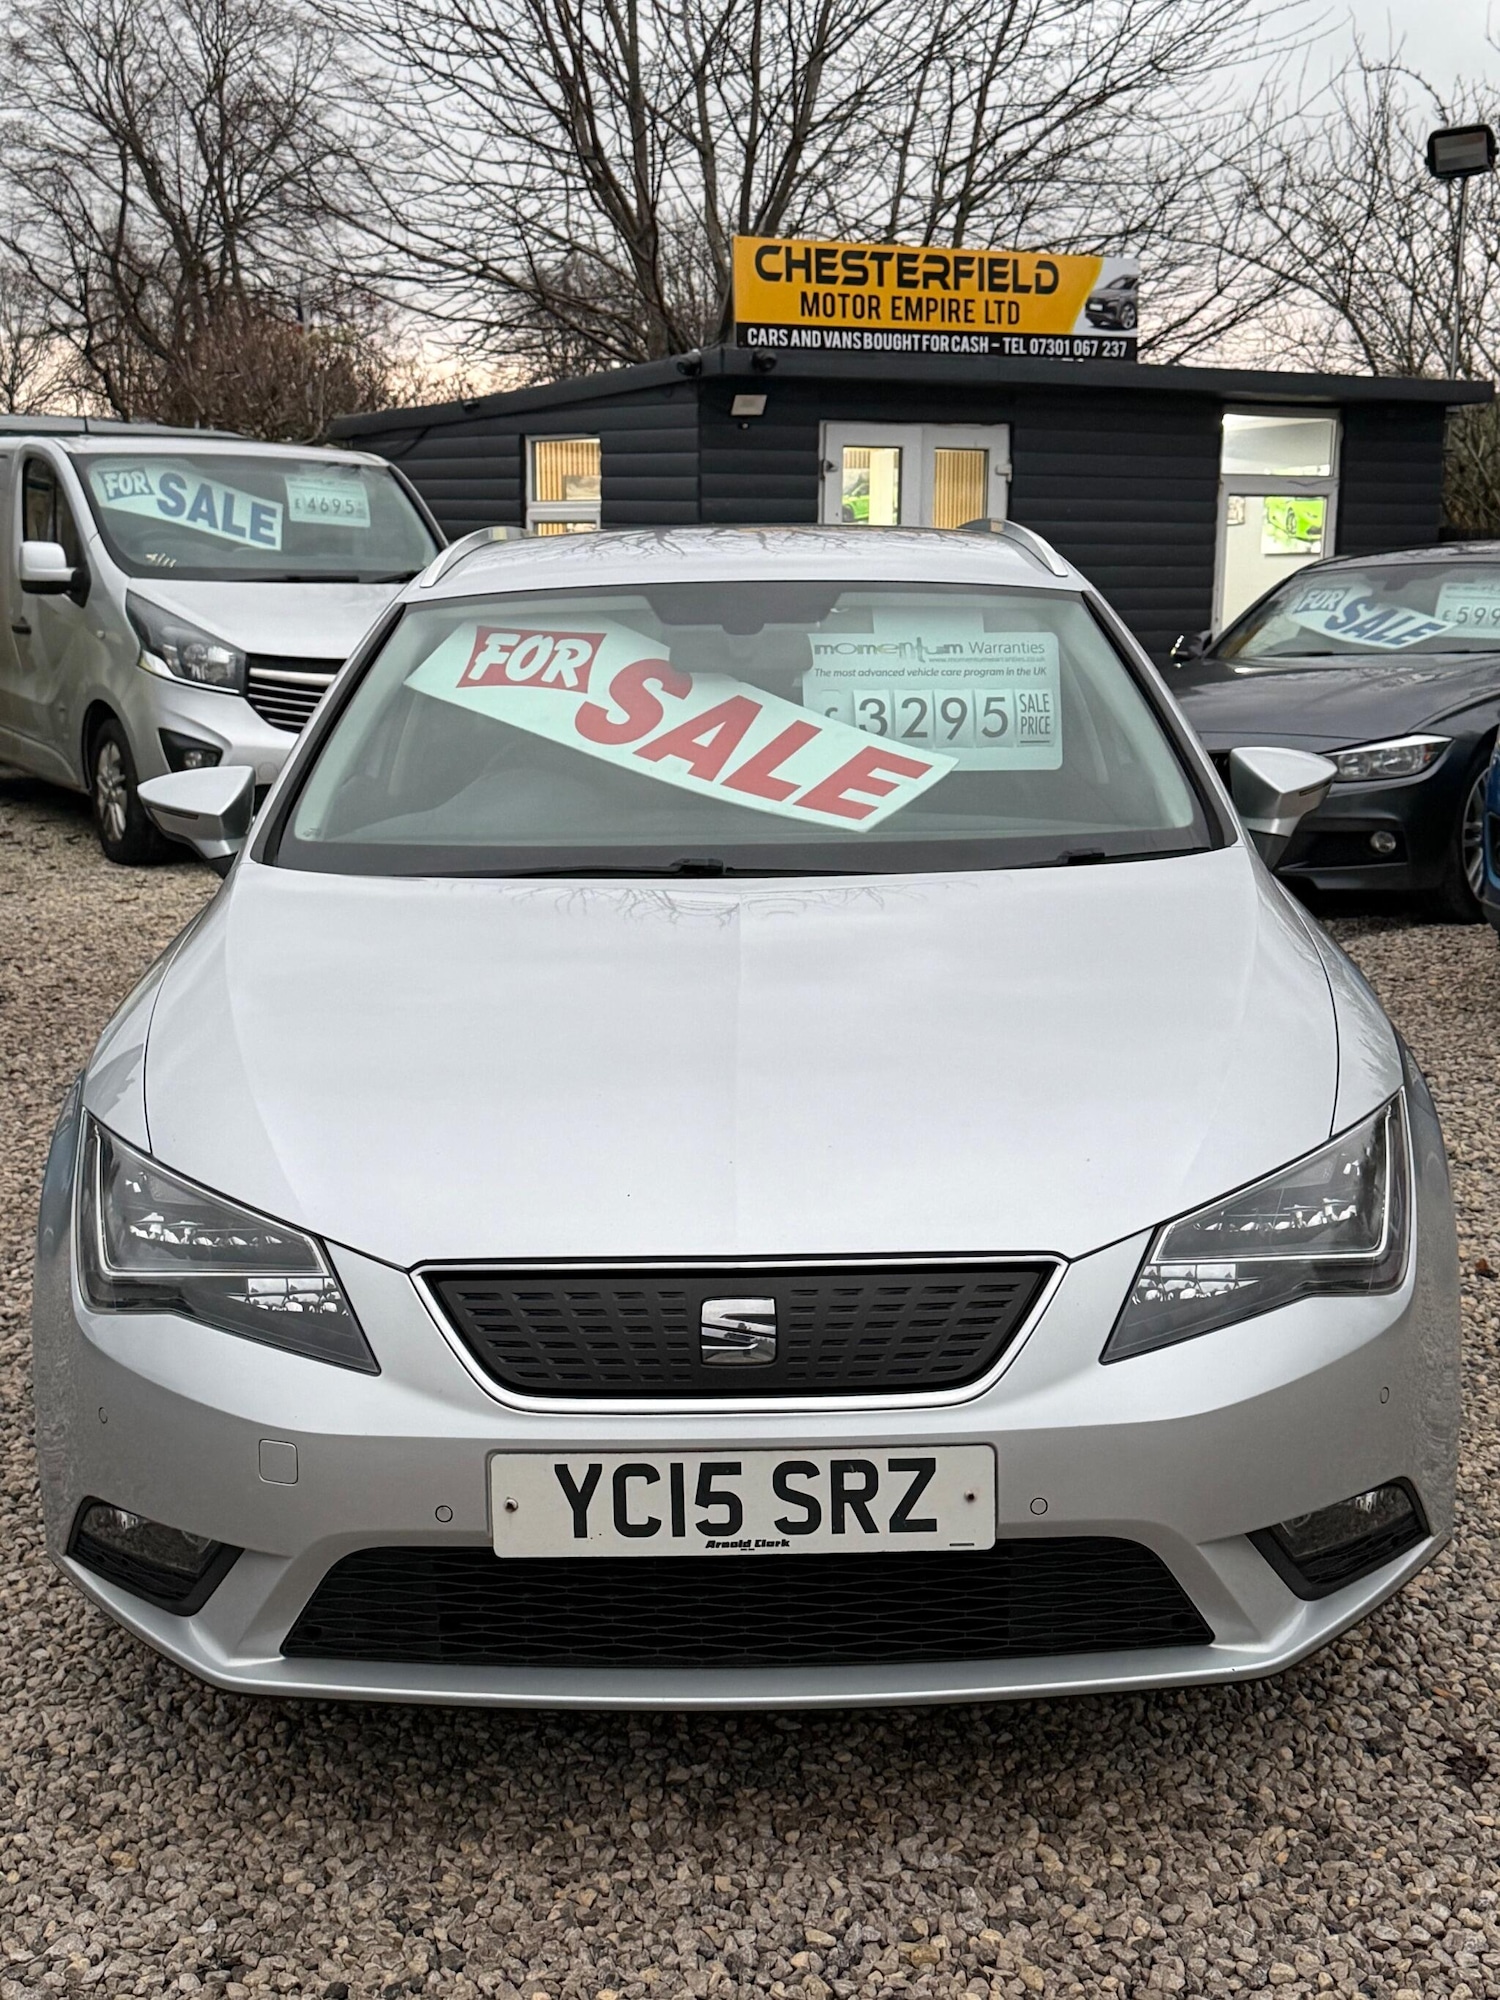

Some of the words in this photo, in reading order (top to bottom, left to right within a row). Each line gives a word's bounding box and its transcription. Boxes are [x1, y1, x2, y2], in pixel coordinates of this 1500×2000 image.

[755, 245, 1059, 294] CHESTERFIELD
[800, 291, 881, 320] MOTOR
[891, 296, 976, 323] EMPIRE
[985, 299, 1020, 325] LTD
[747, 327, 788, 347] CARS
[790, 329, 821, 348] AND
[823, 331, 862, 349] VANS
[863, 332, 922, 351] BOUGHT
[922, 334, 950, 352] FOR
[951, 335, 989, 353] CASH
[1002, 337, 1027, 355] TEL
[1029, 338, 1070, 356] 07301
[1073, 339, 1098, 356] 067
[1102, 340, 1127, 357] 237
[104, 471, 149, 499] FOR
[156, 472, 277, 547] SALE
[1297, 589, 1343, 612] FOR
[1324, 597, 1447, 645] SALE
[968, 641, 1045, 654] Warranties
[815, 668, 832, 677] The
[833, 669, 856, 677] most
[858, 668, 905, 677] advanced
[907, 668, 939, 677] vehicle
[940, 669, 962, 677] care
[963, 669, 1004, 678] program
[1006, 667, 1014, 676] in
[1016, 667, 1031, 676] the
[1033, 667, 1047, 676] UK
[1019, 693, 1050, 713] SALE
[469, 634, 595, 689] FOR
[574, 658, 934, 821] SALE
[1021, 716, 1051, 735] PRICE
[554, 1461, 743, 1539] YC15
[772, 1457, 938, 1535] SRZ
[705, 1539, 752, 1549] Arnold
[754, 1538, 790, 1548] Clark
